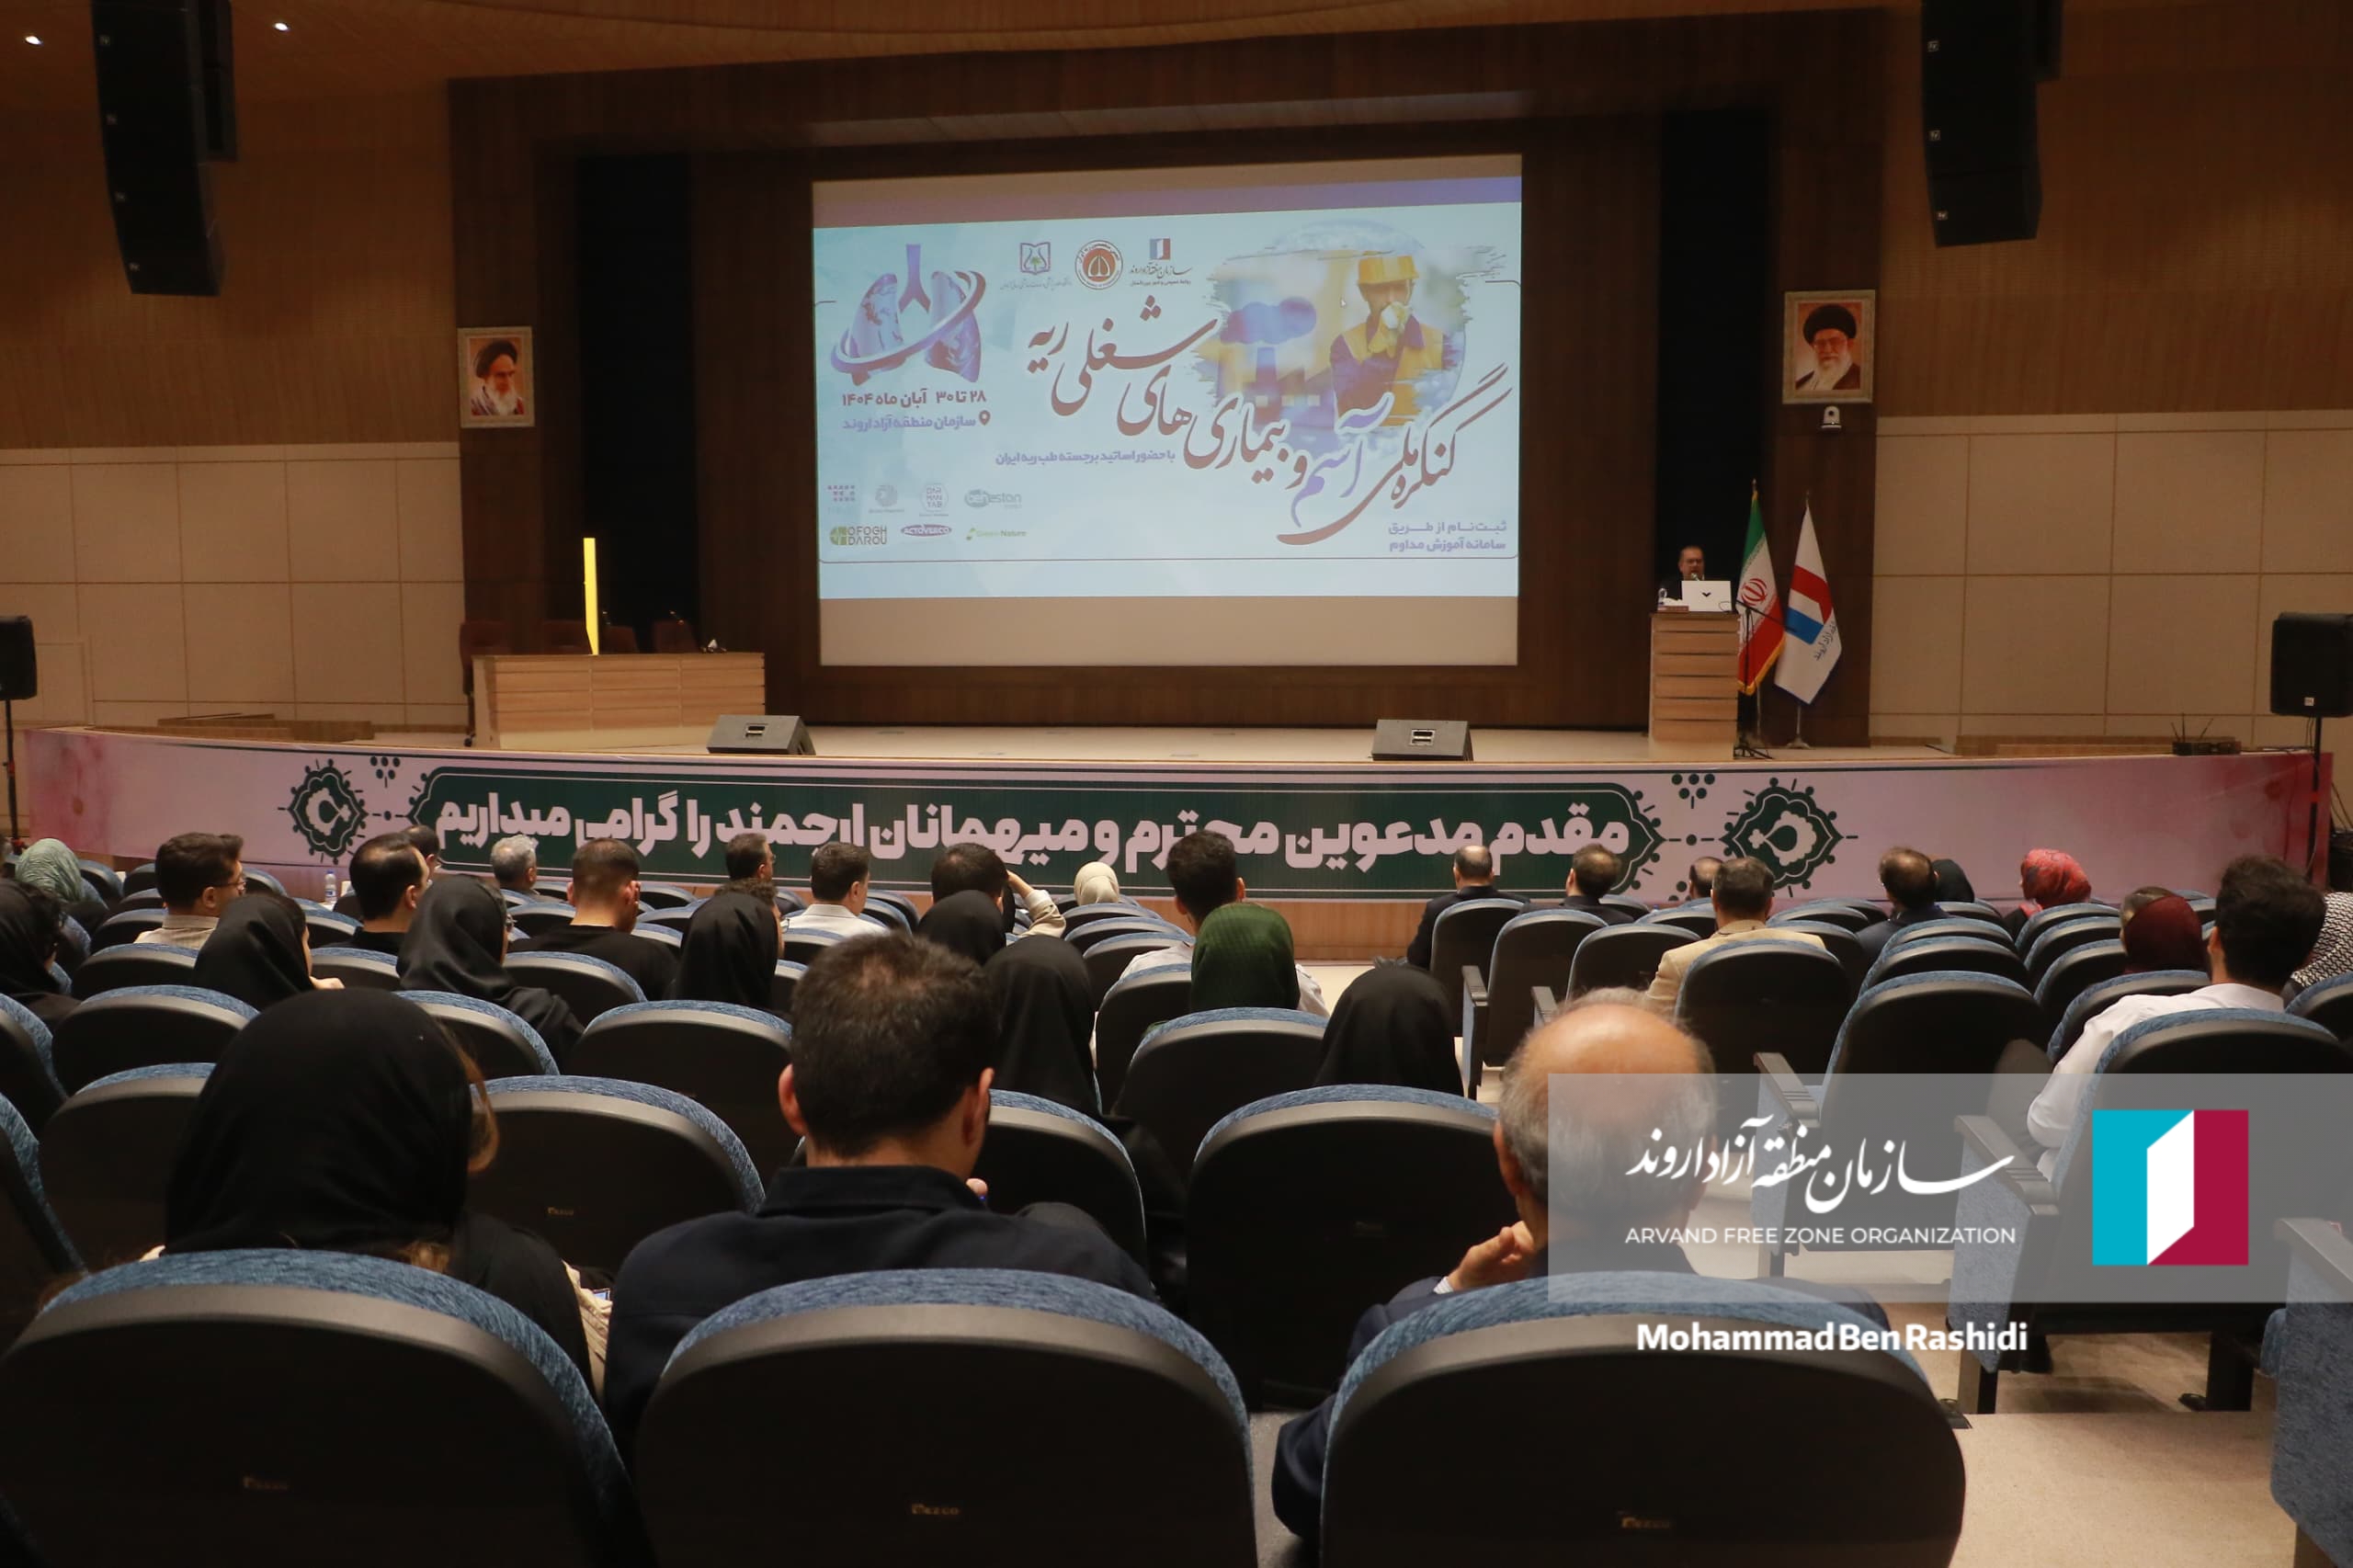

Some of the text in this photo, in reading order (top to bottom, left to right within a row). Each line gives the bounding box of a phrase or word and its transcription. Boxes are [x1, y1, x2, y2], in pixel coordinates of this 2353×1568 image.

[1028, 322, 1069, 373] ریه
[1051, 295, 1218, 416] شغلی
[842, 393, 873, 406] ۱۴۰۴
[876, 392, 897, 405] ماه
[901, 388, 928, 408] آبان
[955, 391, 967, 403] تا
[970, 390, 986, 403] ۲۸
[1117, 364, 1193, 437] های
[842, 415, 976, 432] سازمان منطقه آزاد اروند
[1184, 397, 1290, 483] بیماری
[995, 452, 1020, 466] ایران
[1037, 451, 1058, 466] طب
[1059, 451, 1099, 464] برجسته
[1136, 449, 1166, 463] حضور
[1290, 396, 1391, 528] آسم
[1284, 456, 1308, 490] و
[847, 526, 888, 536] OFOGH
[1388, 521, 1434, 535] طریق
[1435, 521, 1445, 534] از
[847, 536, 888, 546] DAROU
[1389, 537, 1506, 551] سامانه آموزش مداوم
[436, 791, 572, 849] میداریم
[574, 790, 679, 857] گرامی
[686, 799, 711, 858] را
[715, 801, 864, 858] ارجمند
[1094, 819, 1120, 867] و
[1125, 810, 1279, 873] محترم
[1286, 818, 1483, 873] مدعوین
[1490, 802, 1630, 876] مقدم
